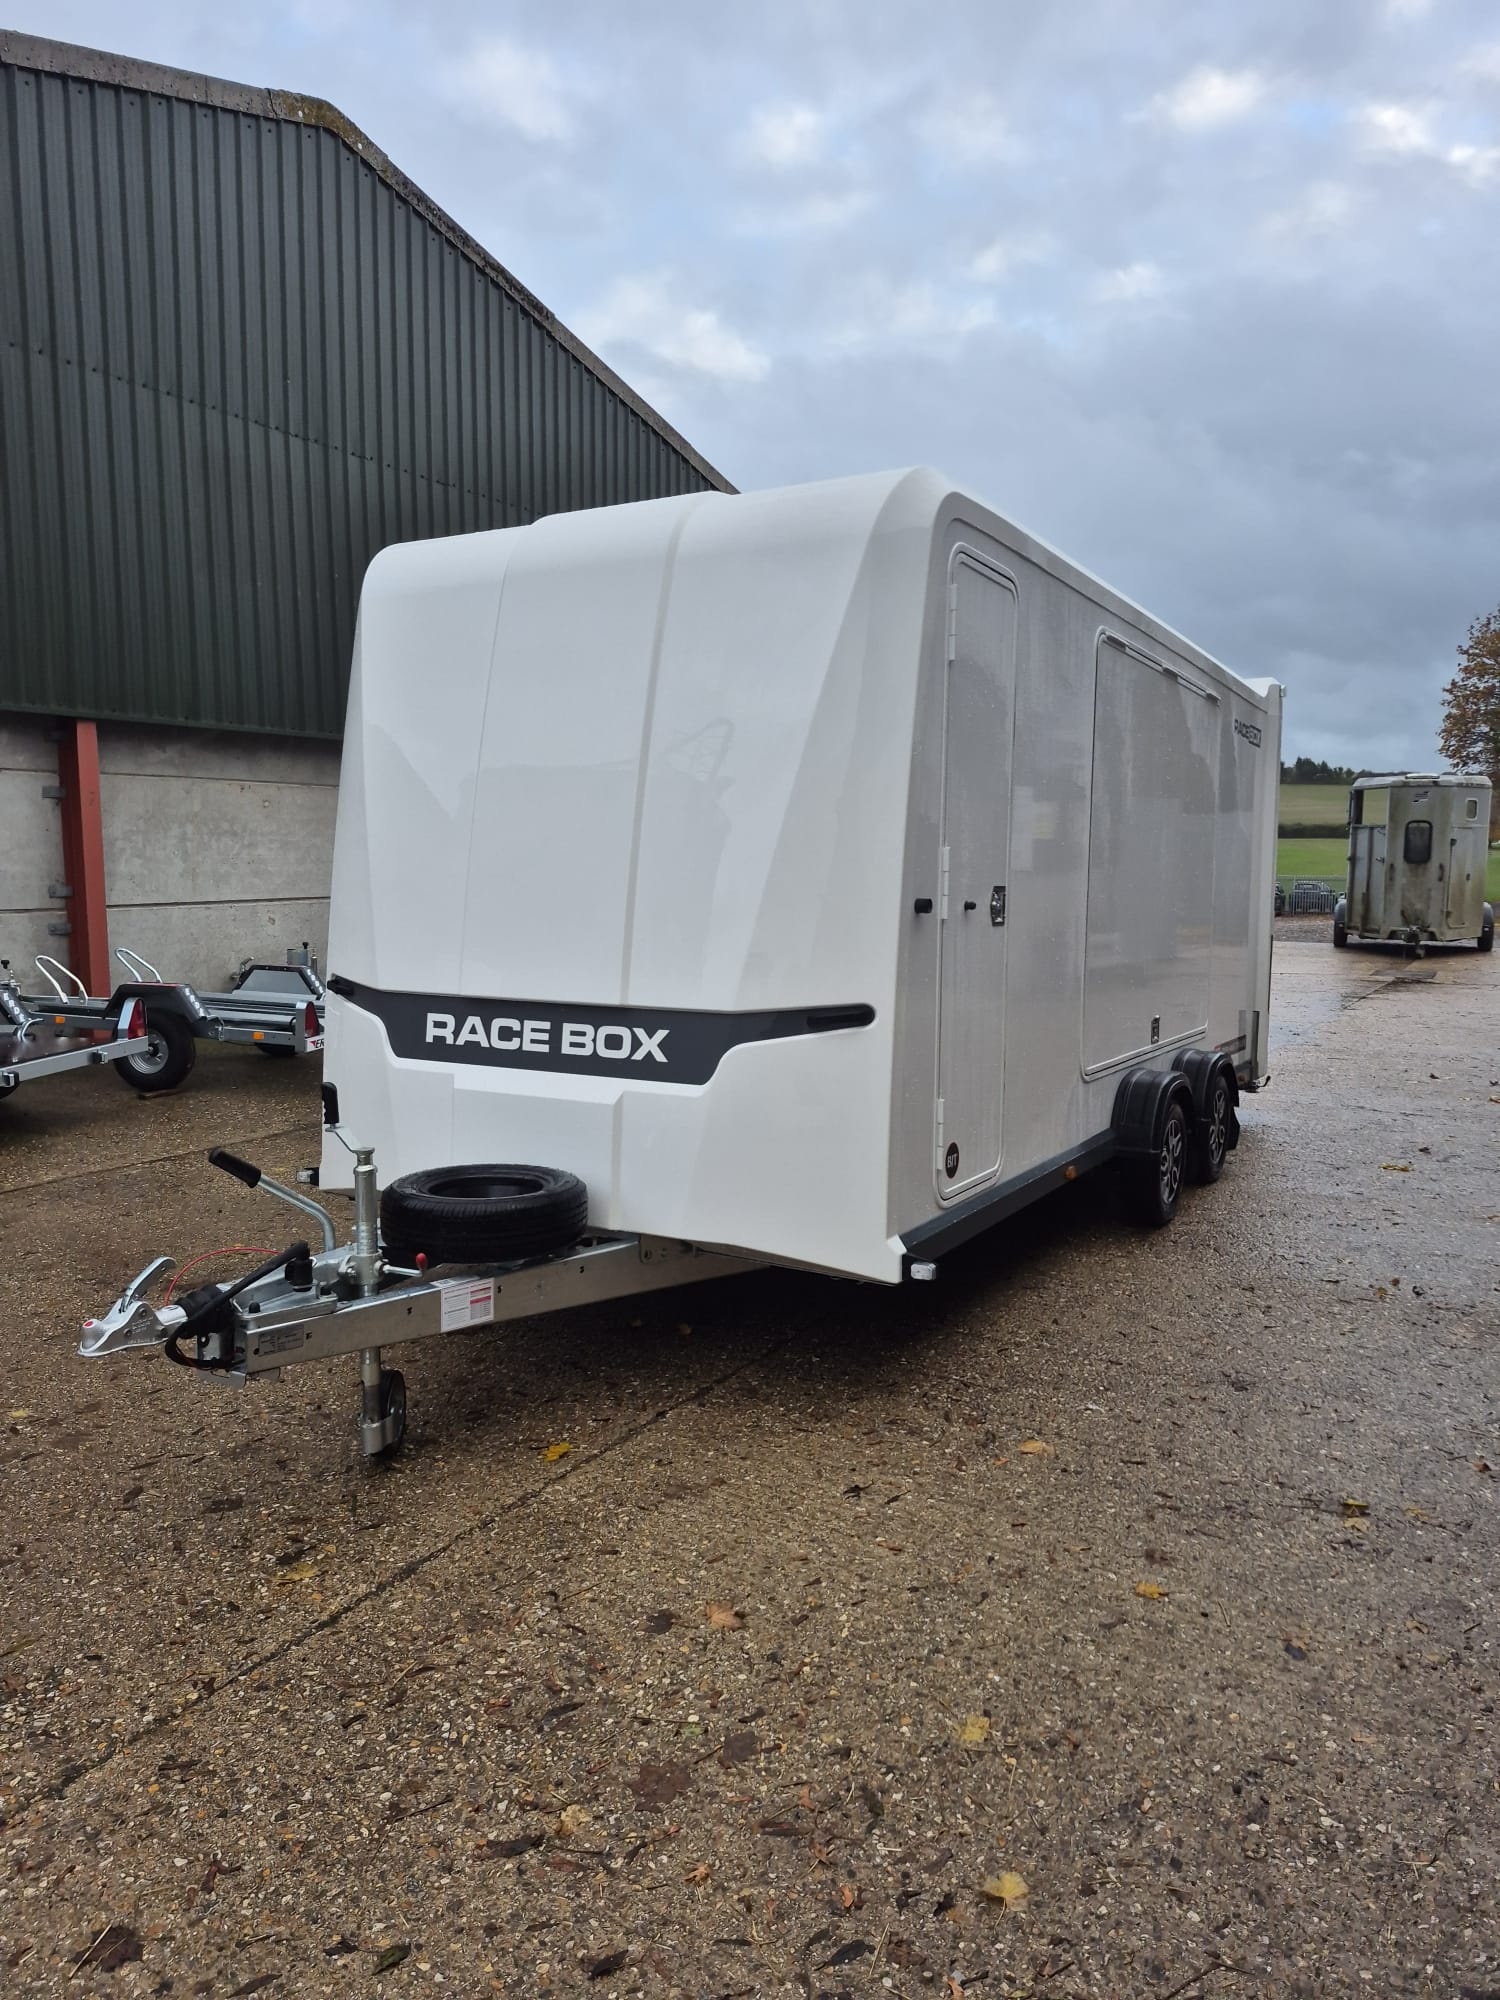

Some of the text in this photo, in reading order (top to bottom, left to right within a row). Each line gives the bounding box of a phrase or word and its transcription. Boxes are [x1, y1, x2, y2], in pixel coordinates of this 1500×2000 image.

[3, 992, 26, 1023] ERDE
[425, 1012, 670, 1063] RACE BOX
